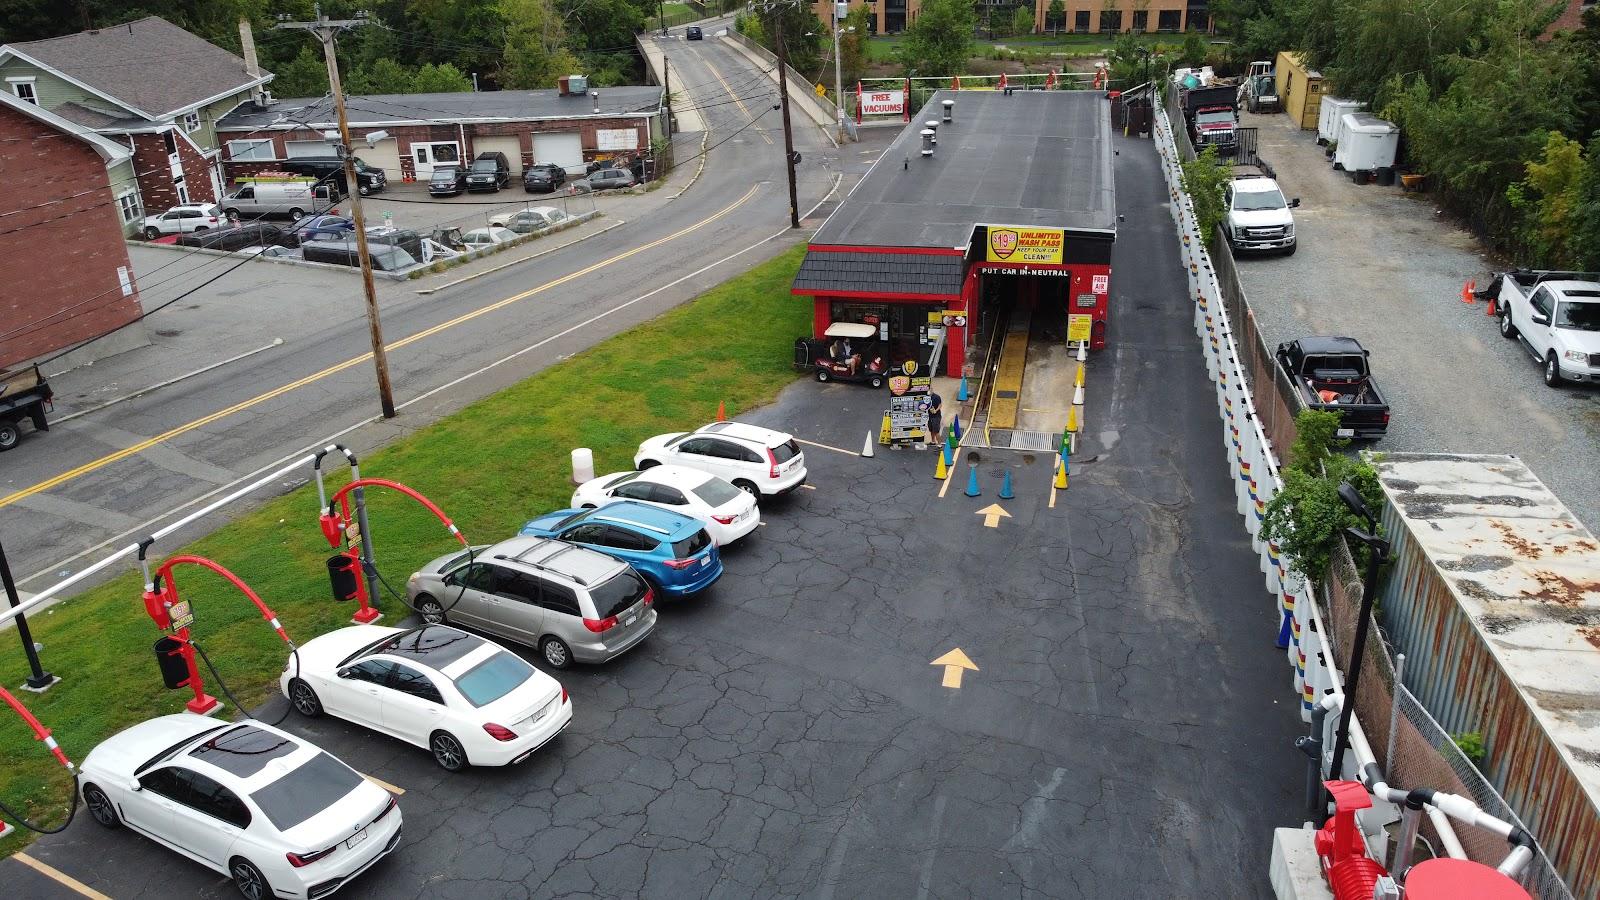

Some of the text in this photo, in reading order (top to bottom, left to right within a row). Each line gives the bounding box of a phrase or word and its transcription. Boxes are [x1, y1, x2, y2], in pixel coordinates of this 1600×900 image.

[864, 104, 902, 112] VACUUMS
[1020, 232, 1061, 240] UNLIMITED
[1018, 239, 1040, 247] WASH
